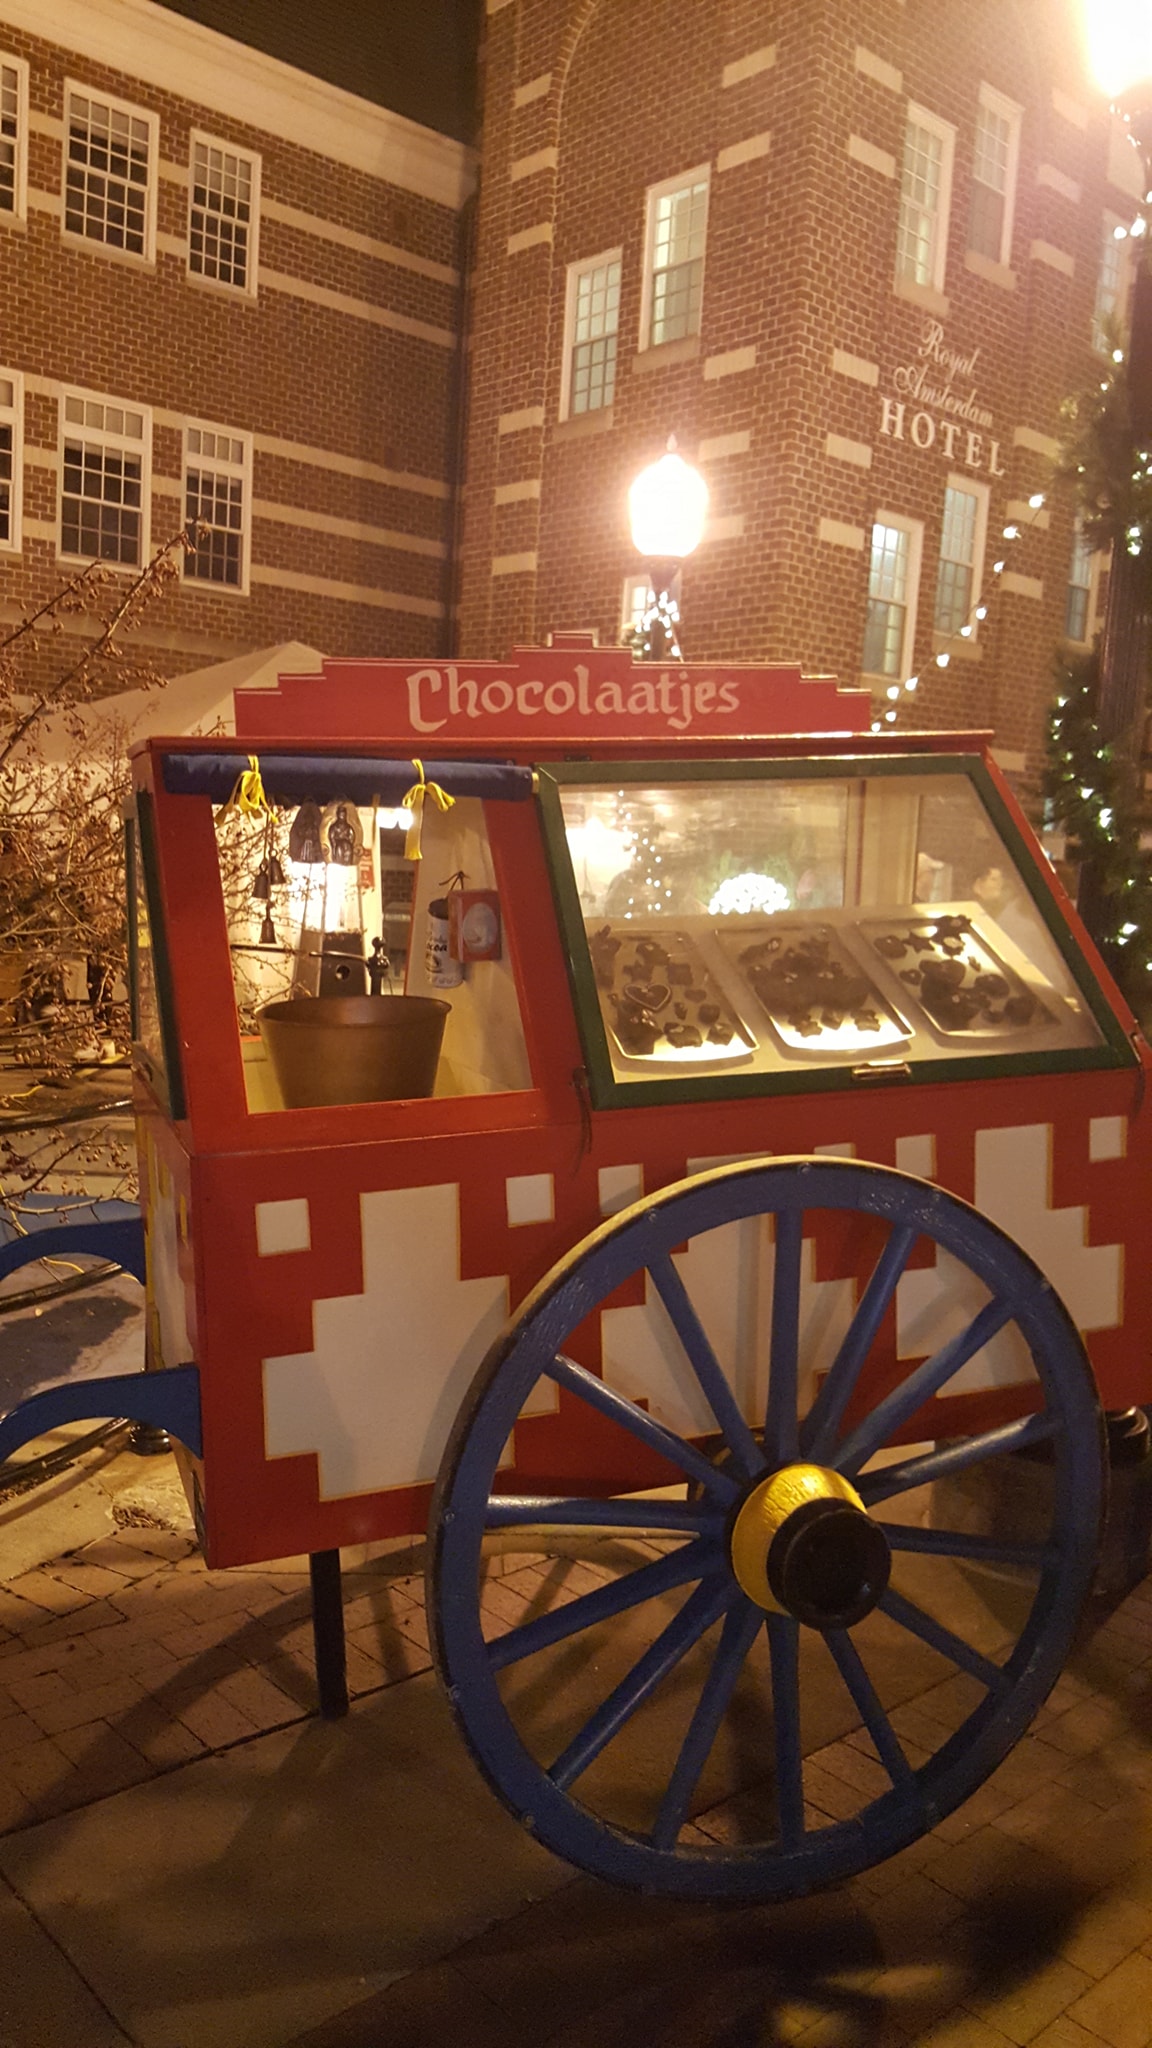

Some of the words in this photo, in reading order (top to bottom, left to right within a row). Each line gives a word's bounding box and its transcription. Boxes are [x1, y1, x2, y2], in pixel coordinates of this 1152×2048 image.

[918, 318, 980, 383] Royal
[893, 364, 994, 428] Amsterdam
[879, 396, 1006, 477] HOTEL
[405, 664, 741, 733] Chocolaatjes
